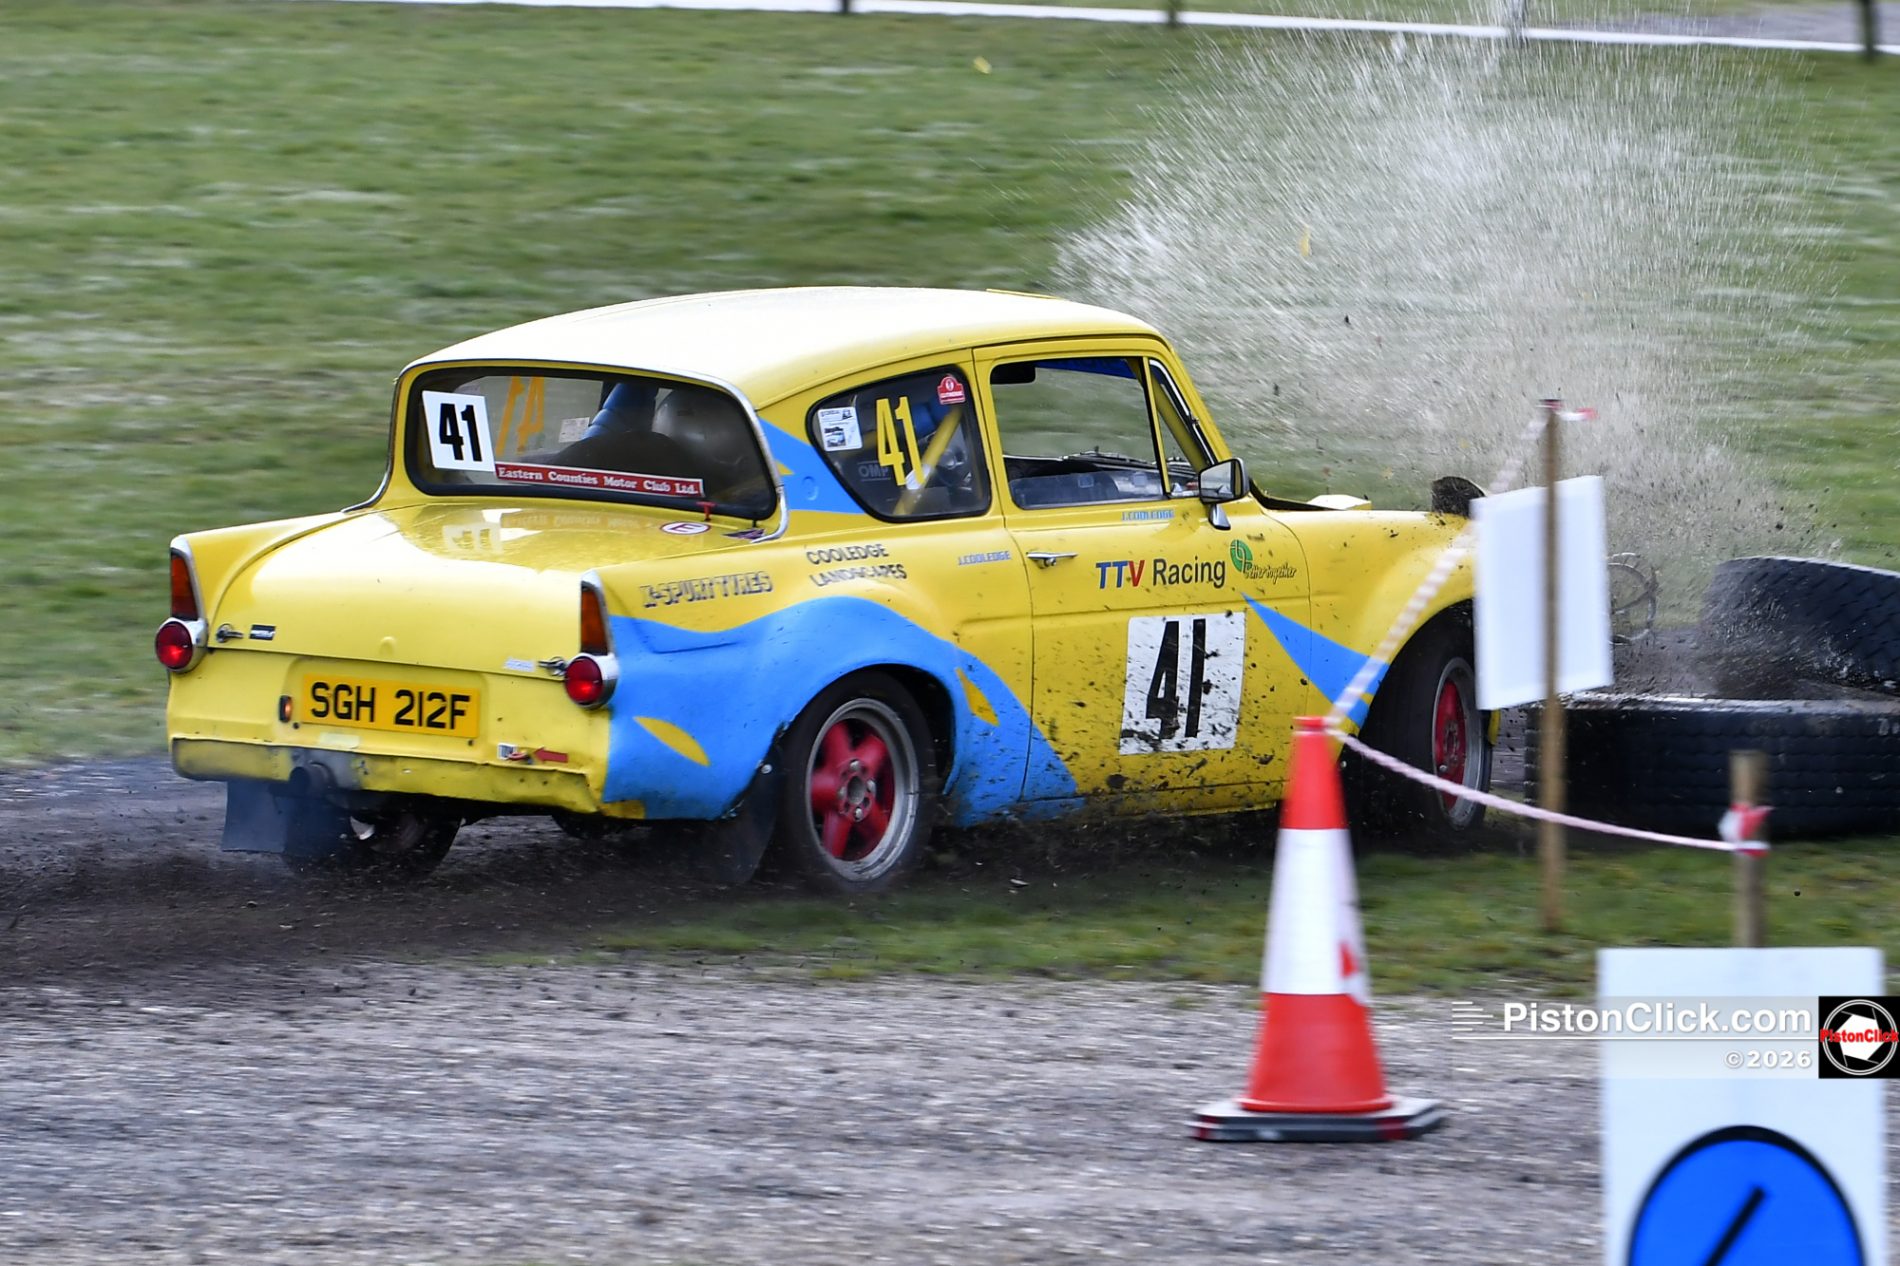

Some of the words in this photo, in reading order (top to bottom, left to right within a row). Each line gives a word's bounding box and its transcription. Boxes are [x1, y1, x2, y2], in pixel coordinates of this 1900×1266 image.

[439, 402, 482, 461] 41
[876, 396, 925, 486] 41
[498, 465, 543, 481] Eastern
[548, 471, 598, 486] Counties
[603, 475, 637, 489] Motor
[643, 480, 671, 492] Club
[675, 482, 699, 494] Ltd.
[806, 543, 889, 565] COOLEDGE
[1096, 560, 1146, 589] TTV
[1152, 556, 1226, 588] Racing
[809, 563, 907, 587] LANDSCAPES
[1146, 618, 1206, 740] 41
[311, 681, 376, 723] SGH
[394, 689, 471, 730] 212F
